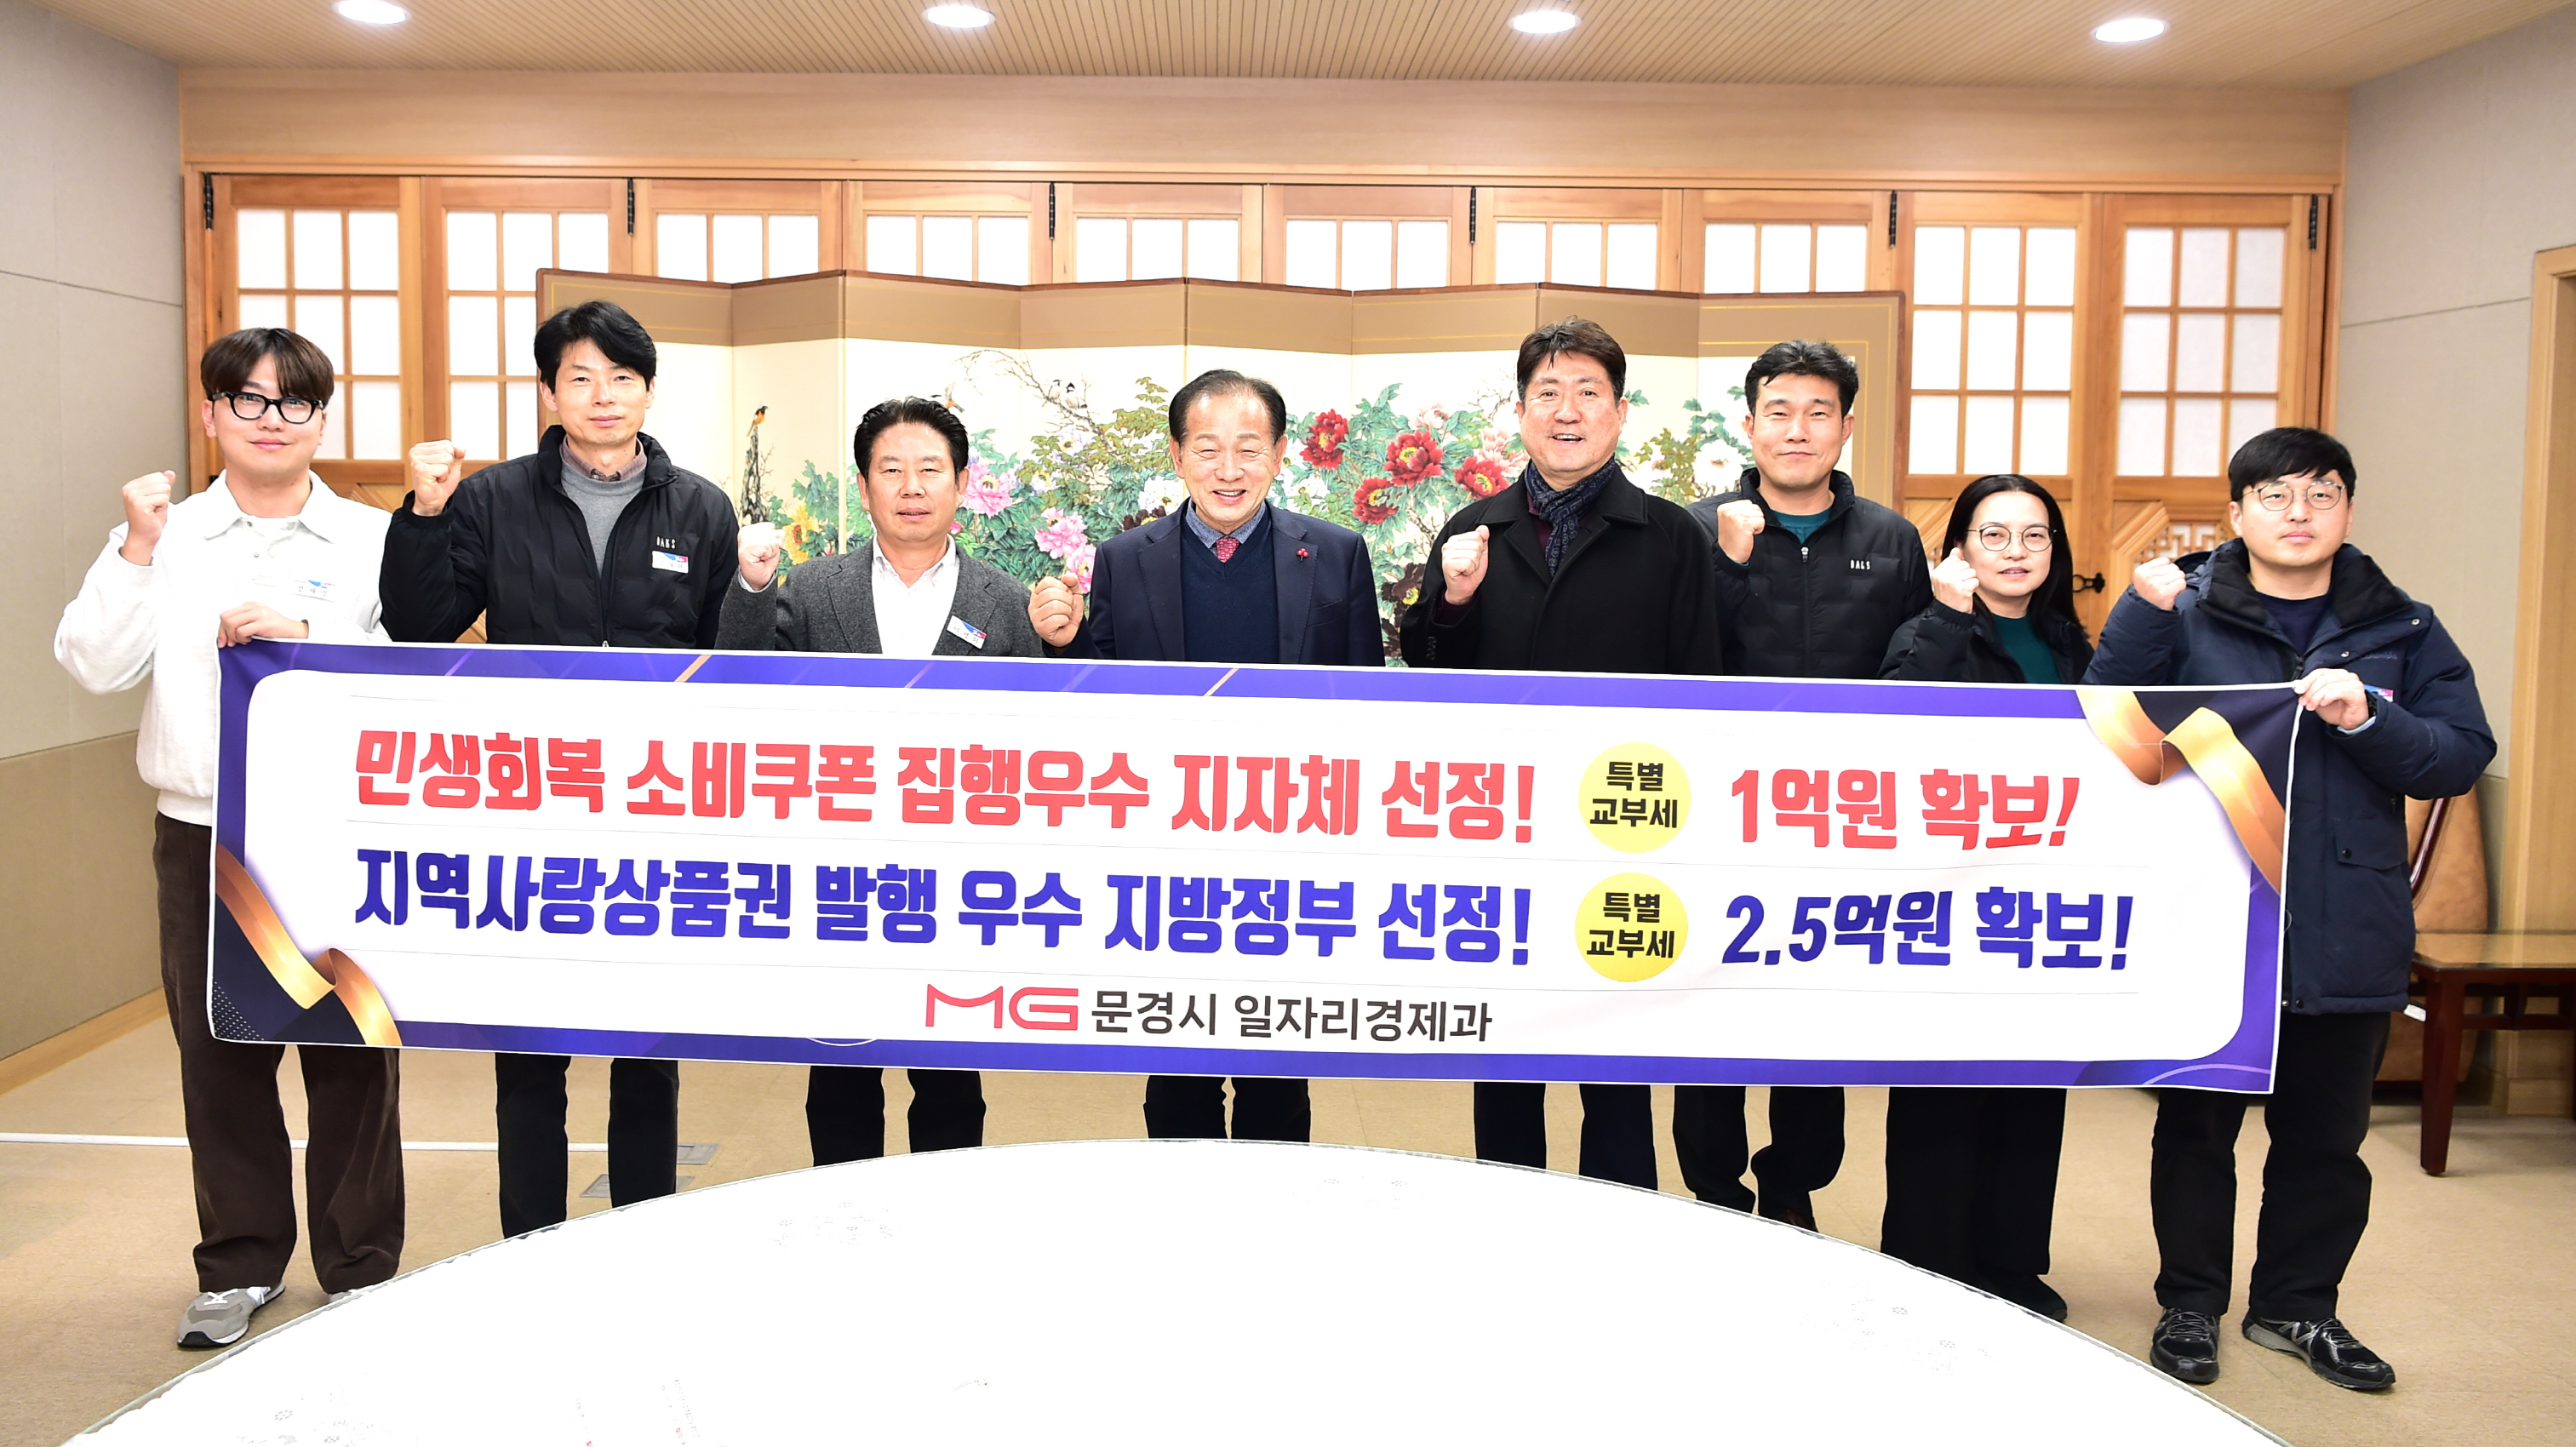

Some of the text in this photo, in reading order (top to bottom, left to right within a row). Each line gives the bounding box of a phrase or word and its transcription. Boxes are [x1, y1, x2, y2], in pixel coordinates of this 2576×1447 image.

[356, 730, 1534, 843] 민생회복 소비쿠폰 집행우수 지자체 선정!
[1606, 762, 1663, 791] 특별
[1590, 798, 1677, 827] 교부세
[1732, 769, 2080, 850] 1억원 확보!
[356, 849, 1531, 965] 지역사랑상품권 발행 우수 지방정부 선정!
[1604, 893, 1659, 923] 특별
[1723, 887, 2133, 969] 2.5억원 확보!
[1587, 929, 1674, 958] 교부세
[926, 984, 1079, 1031] MG
[1092, 991, 1492, 1041] 문경시 일자리경제과
